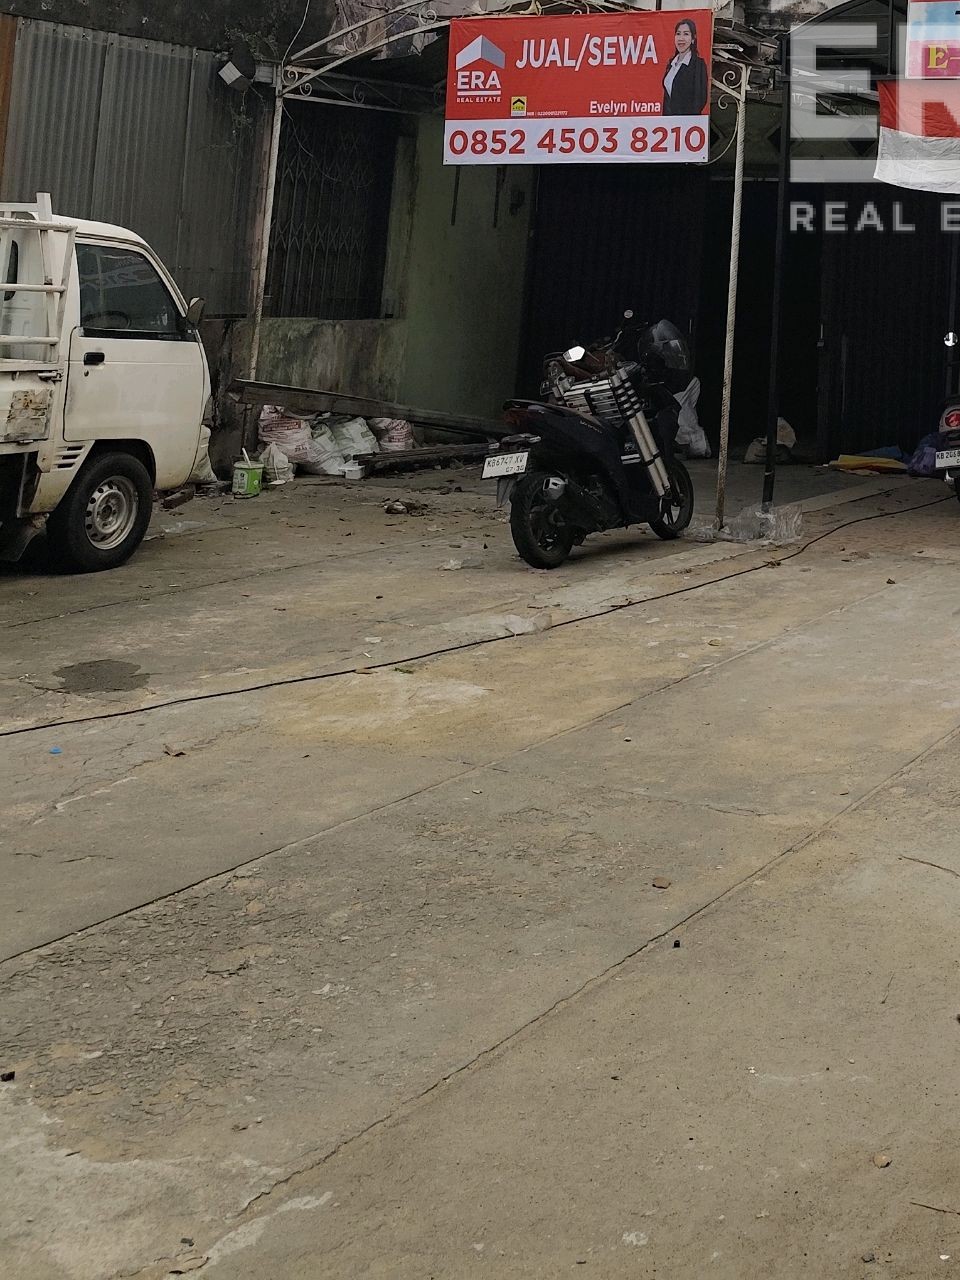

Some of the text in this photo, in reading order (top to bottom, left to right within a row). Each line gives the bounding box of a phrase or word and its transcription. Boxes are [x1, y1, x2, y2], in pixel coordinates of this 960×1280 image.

[515, 33, 659, 71] JUAL/SEWA
[457, 71, 502, 89] ERA
[589, 100, 661, 116] Evelyn Ivana
[449, 125, 706, 155] 0852 4503 8210
